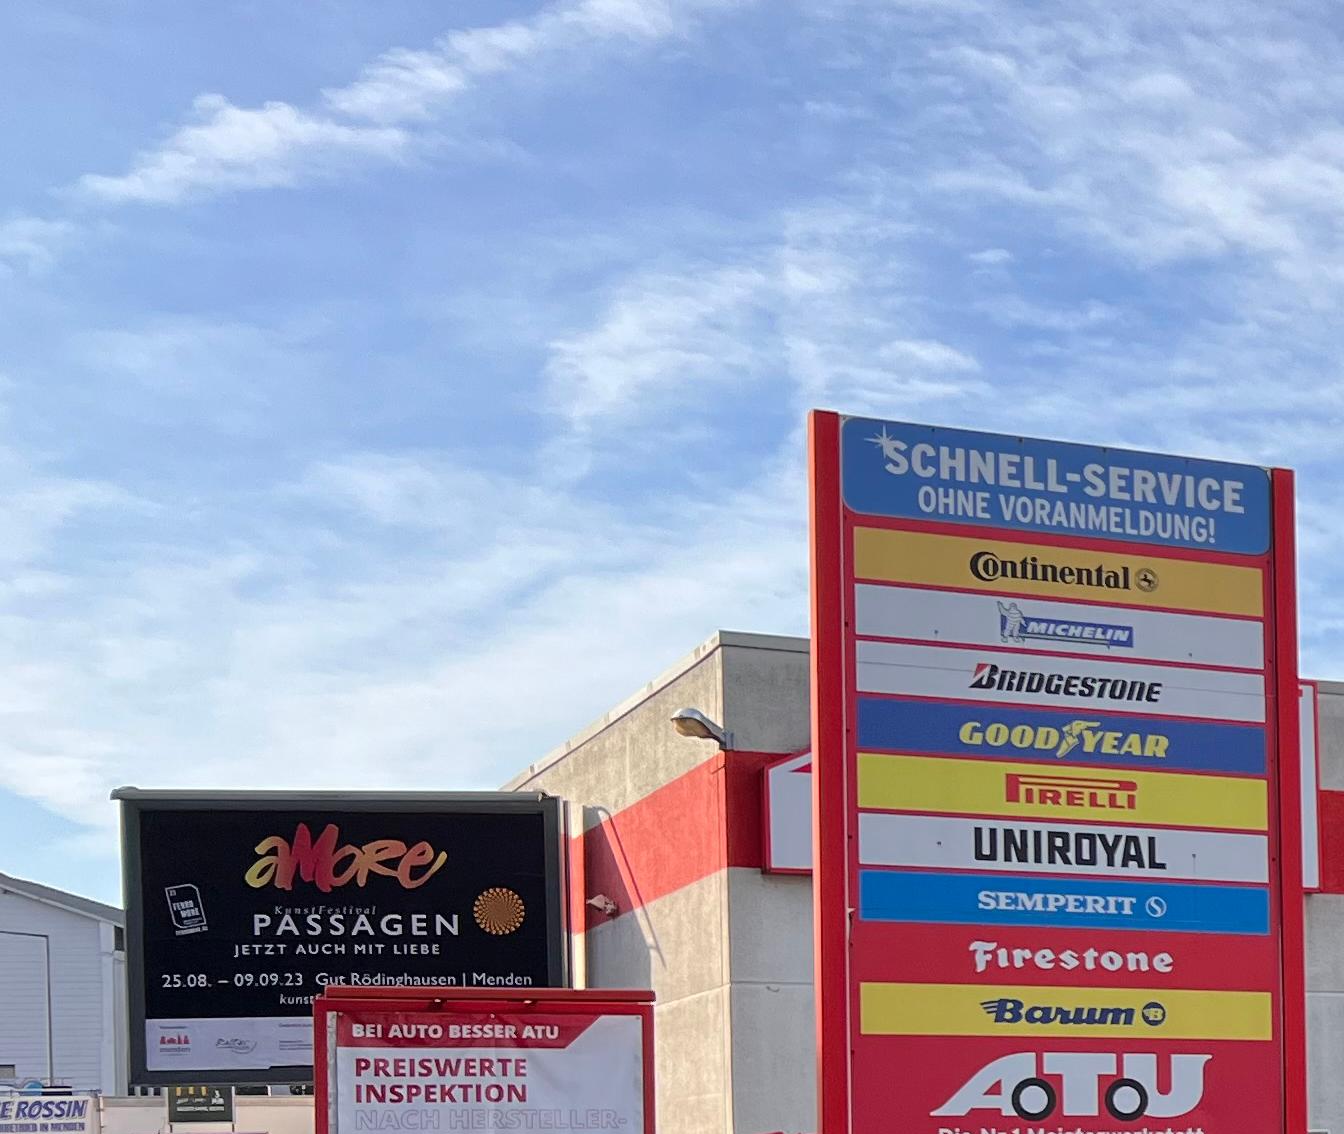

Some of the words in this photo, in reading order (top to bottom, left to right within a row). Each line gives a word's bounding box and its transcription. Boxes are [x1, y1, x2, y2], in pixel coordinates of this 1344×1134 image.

[884, 440, 1246, 515] SCHNELL-SERVICE
[917, 485, 991, 520] OHNE
[1000, 494, 1216, 544] VORANMELDUNG!
[969, 551, 1130, 590] Continental
[1026, 621, 1130, 642] MICHELIN
[968, 663, 1163, 702] BRIDGESTONE
[1005, 773, 1138, 810] PIRELLI
[973, 826, 1168, 870] UNIROYAL
[274, 905, 377, 915] KunstFestival
[977, 890, 1137, 916] SEMPERIT
[253, 913, 459, 936] PASSAGEN
[233, 943, 287, 958] JETZT
[295, 943, 345, 955] AUCH
[354, 943, 385, 955] MIT
[393, 943, 440, 955] LIEBE
[968, 940, 1174, 973] Firestone
[161, 973, 213, 988] 25.08.
[233, 973, 304, 987] 09.09.23
[315, 972, 346, 986] Gut
[350, 972, 457, 987] Rödinghausen
[472, 972, 533, 986] Menden
[981, 998, 1135, 1026] Barum
[352, 1023, 383, 1038] BEI
[388, 1024, 443, 1039] AUTO
[449, 1024, 517, 1039] BESSER
[522, 1025, 559, 1040] ATU
[355, 1058, 527, 1078] PREISWERTE
[355, 1083, 527, 1104] INSPEKTION
[929, 1051, 1214, 1122] ATU
[15, 1100, 87, 1119] ROSSIN
[354, 1109, 440, 1131] NACH
[449, 1108, 628, 1130] HERSTELLER-
